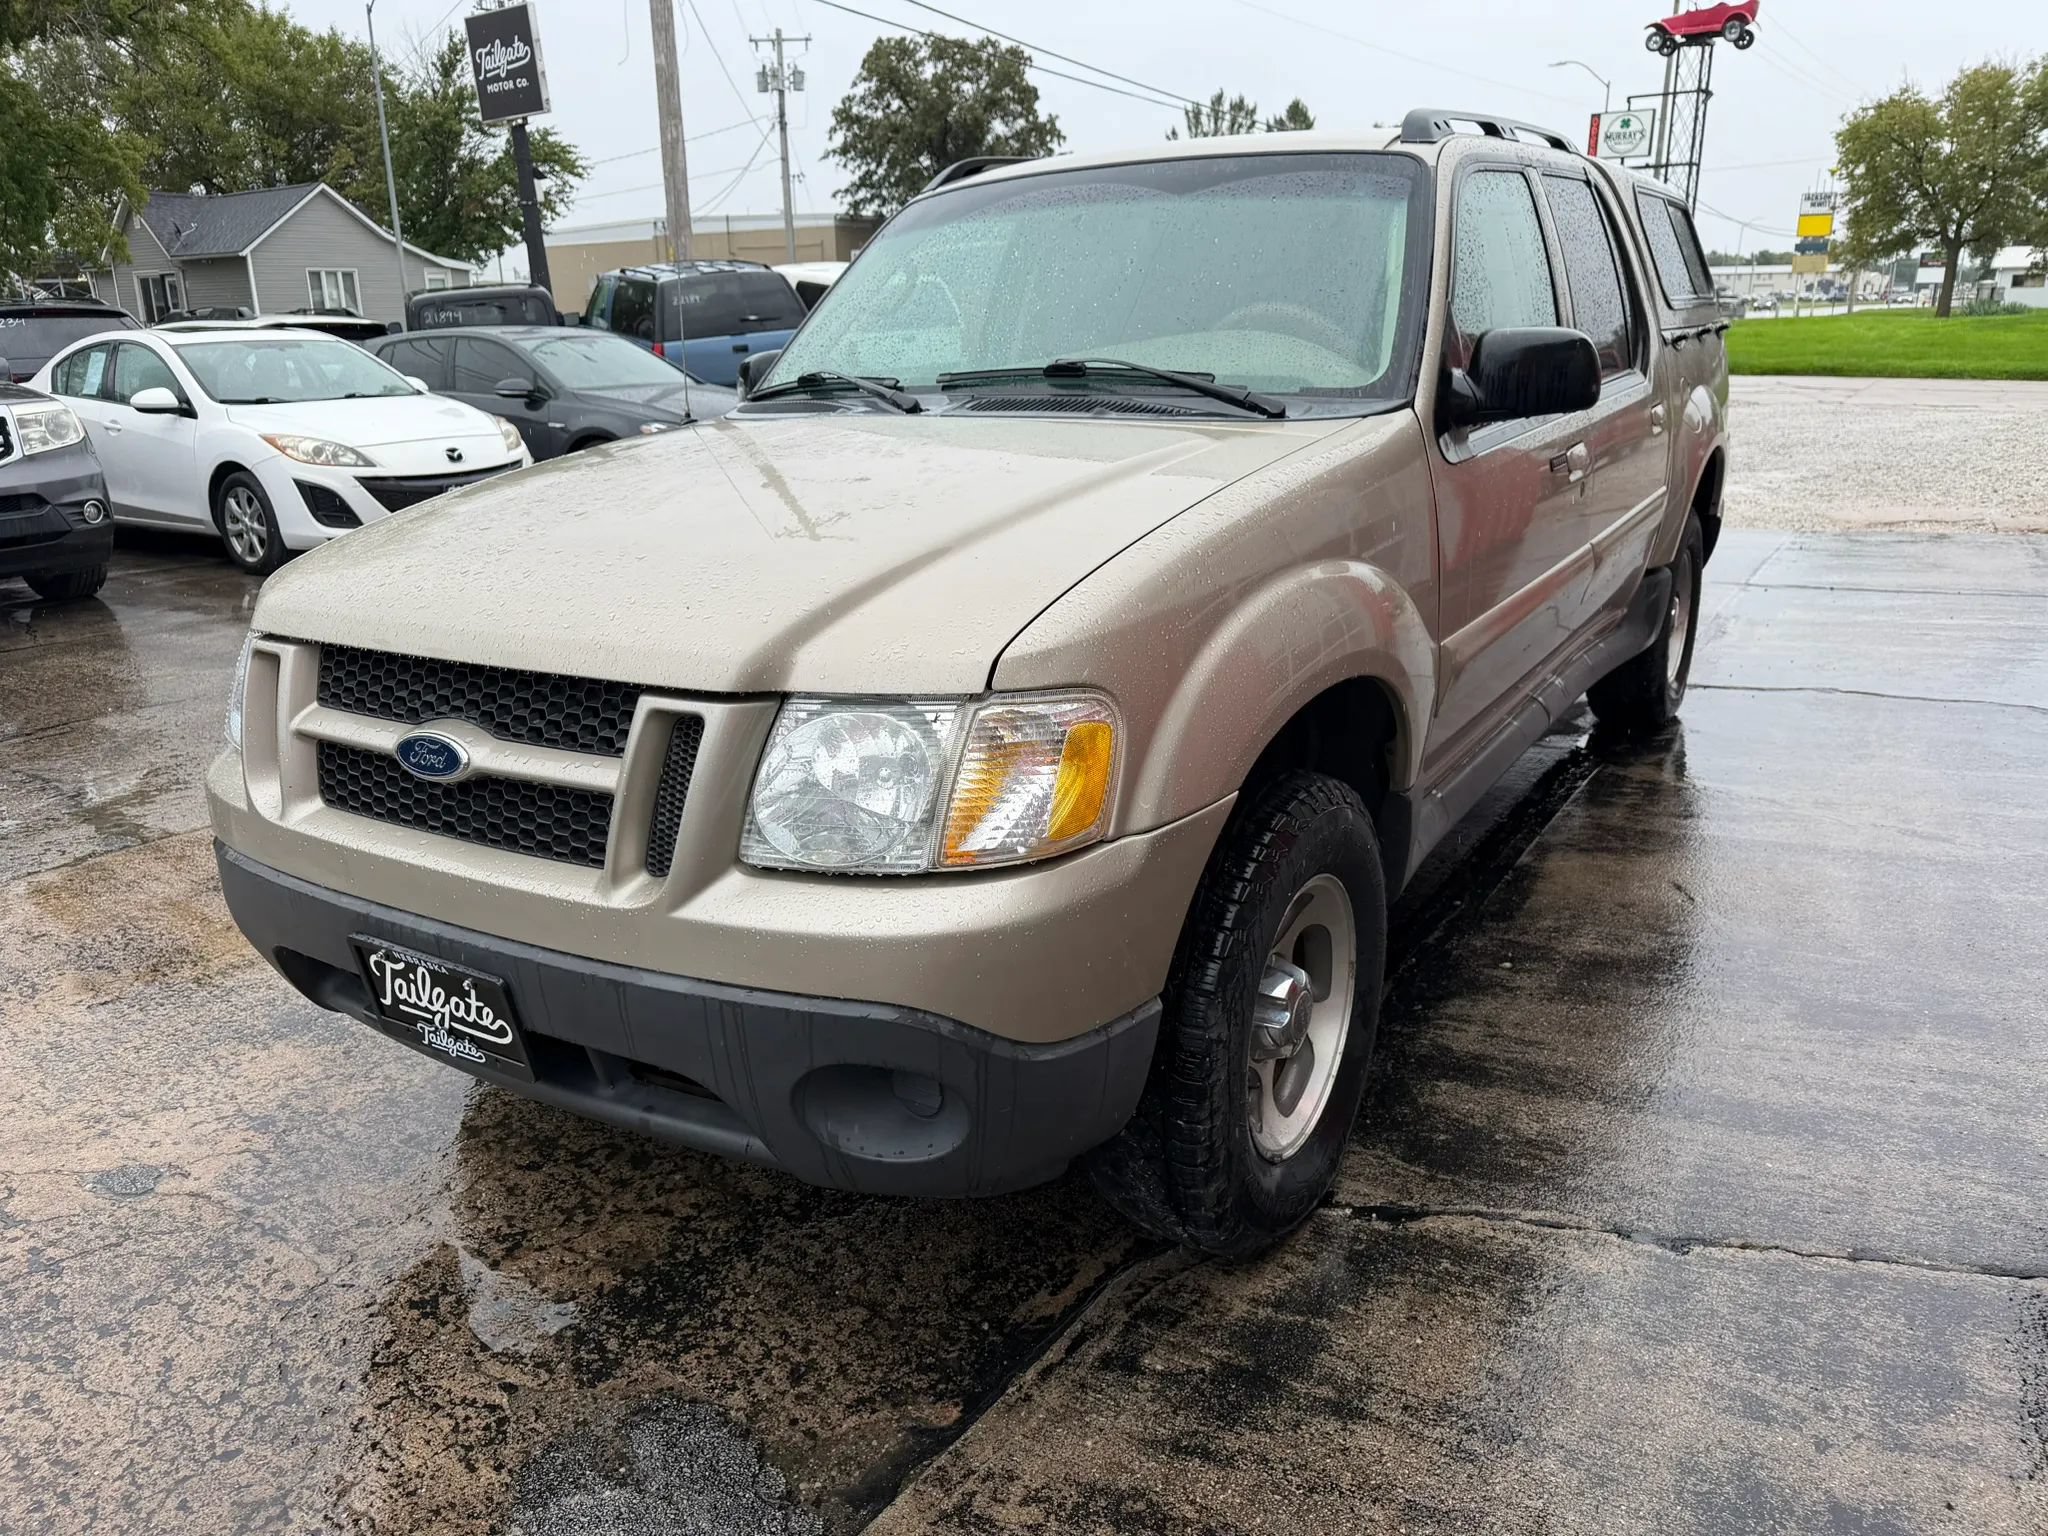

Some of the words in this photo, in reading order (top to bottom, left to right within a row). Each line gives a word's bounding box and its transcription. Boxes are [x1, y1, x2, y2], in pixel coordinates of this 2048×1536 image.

[475, 34, 532, 81] Tailgate
[486, 79, 515, 94] MOTOR
[423, 311, 463, 325] 21894
[409, 740, 448, 769] Ford
[392, 951, 449, 975] NEBRASKA
[369, 953, 513, 1045] Tailgate
[416, 1021, 487, 1064] Tailgate
